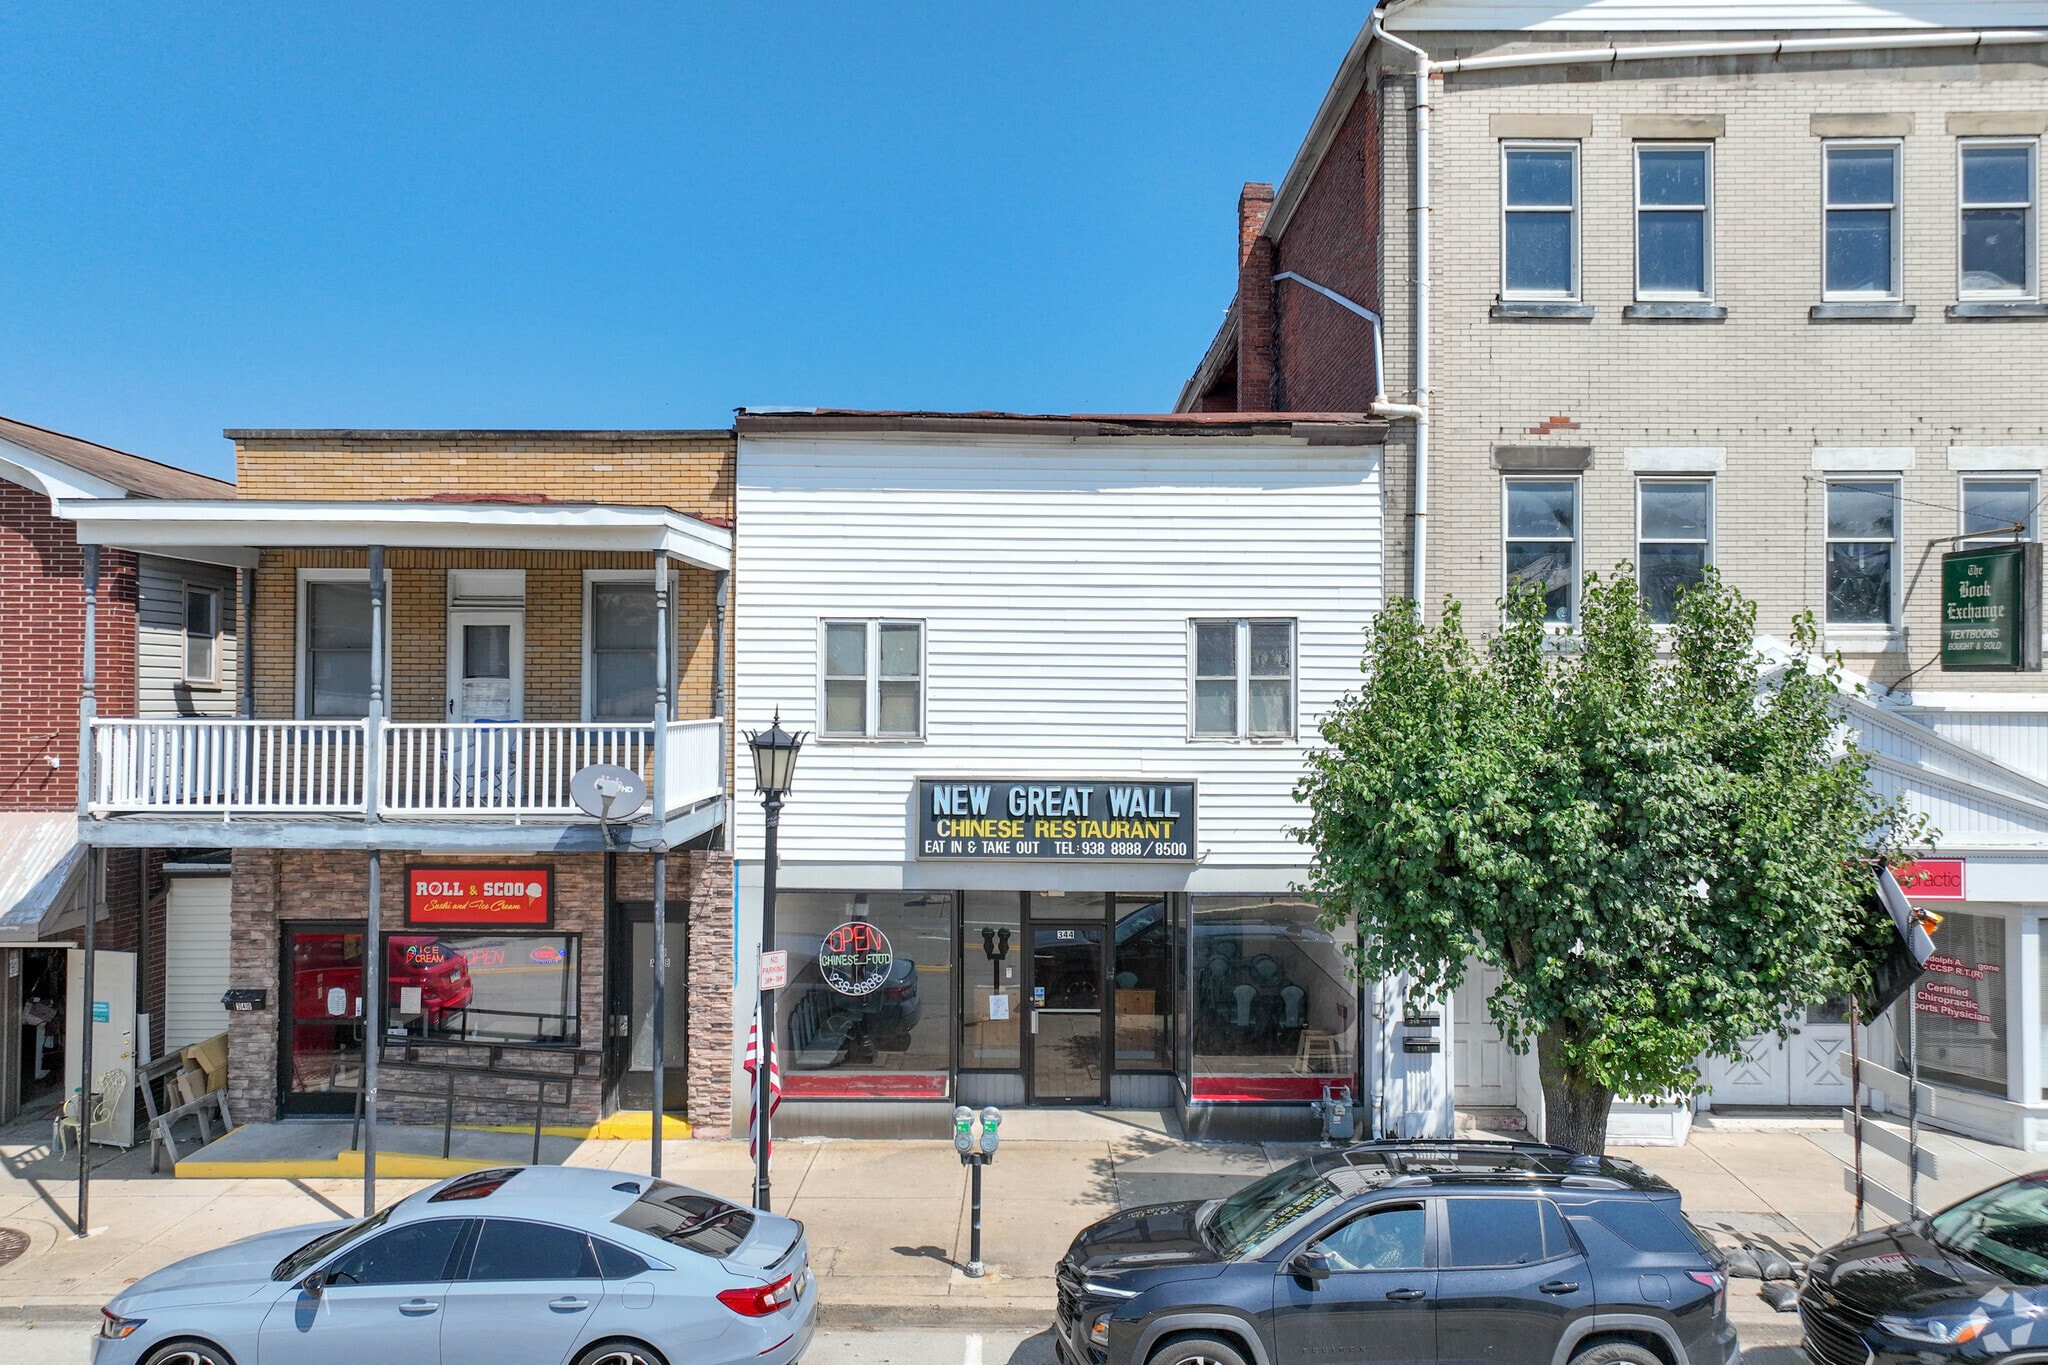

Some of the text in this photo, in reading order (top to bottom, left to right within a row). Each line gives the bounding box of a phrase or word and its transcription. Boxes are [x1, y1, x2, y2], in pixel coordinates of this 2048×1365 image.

[1968, 564, 1983, 577] The
[1959, 580, 1991, 598] Book
[1947, 602, 2005, 623] Exchange
[1950, 628, 2000, 639] TEXTBOOKS
[1948, 642, 1974, 650] BOUGHT
[1983, 641, 2001, 650] SOLD
[933, 784, 1180, 818] NEW GREAT WALL
[937, 819, 1174, 839] CHINESE RESTAURANT
[925, 840, 946, 853] EAT
[951, 841, 962, 853] IN
[967, 841, 977, 853] &
[982, 841, 1011, 854] TAKE
[1016, 841, 1040, 854] OUT
[415, 881, 464, 896] ROLL
[469, 885, 478, 896] &
[424, 899, 520, 911] Sushi and Ice Cream
[829, 925, 882, 953] OPEN
[1057, 930, 1074, 939] 344
[419, 946, 439, 954] ICE
[415, 954, 445, 963] CREAM
[463, 948, 505, 967] OPEN
[770, 956, 778, 964] NO
[821, 953, 891, 967] CHINESE FOOD
[762, 965, 785, 974] PARKING
[1930, 963, 1954, 973] CCSP
[1926, 982, 1969, 997] Certified
[1917, 991, 1979, 1010] Chiropractic
[1914, 1002, 1990, 1022] ports Physician
